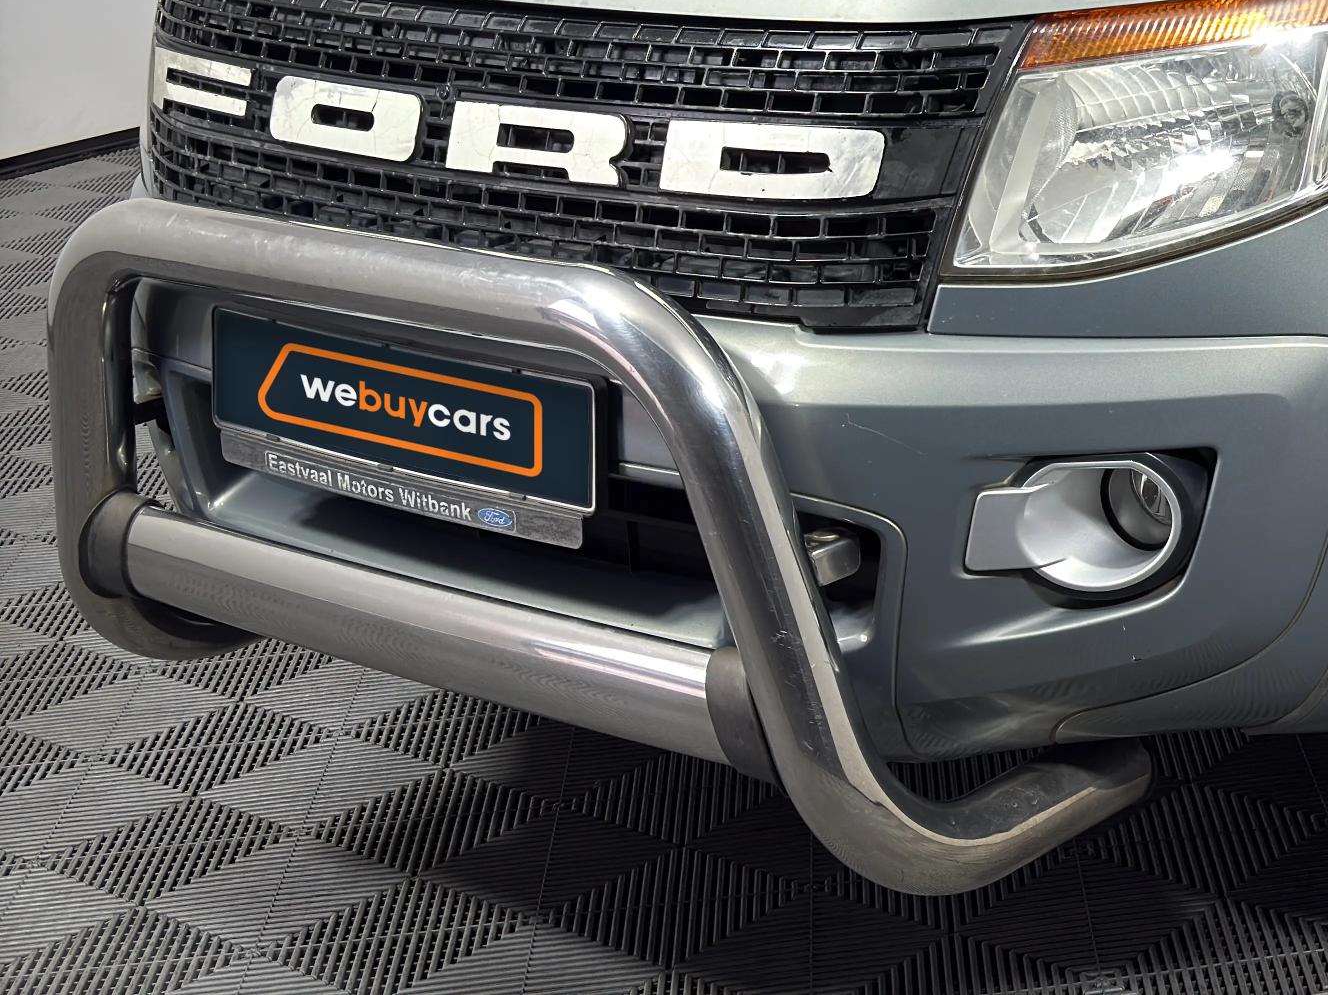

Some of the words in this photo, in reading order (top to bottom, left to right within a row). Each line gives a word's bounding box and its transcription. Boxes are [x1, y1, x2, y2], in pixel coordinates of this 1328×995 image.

[153, 46, 885, 199] FORD
[300, 373, 511, 441] webuycars
[268, 454, 332, 487] Eastvaal
[337, 471, 394, 503] Motors
[398, 487, 473, 521] Witbank
[482, 509, 507, 527] Ford
